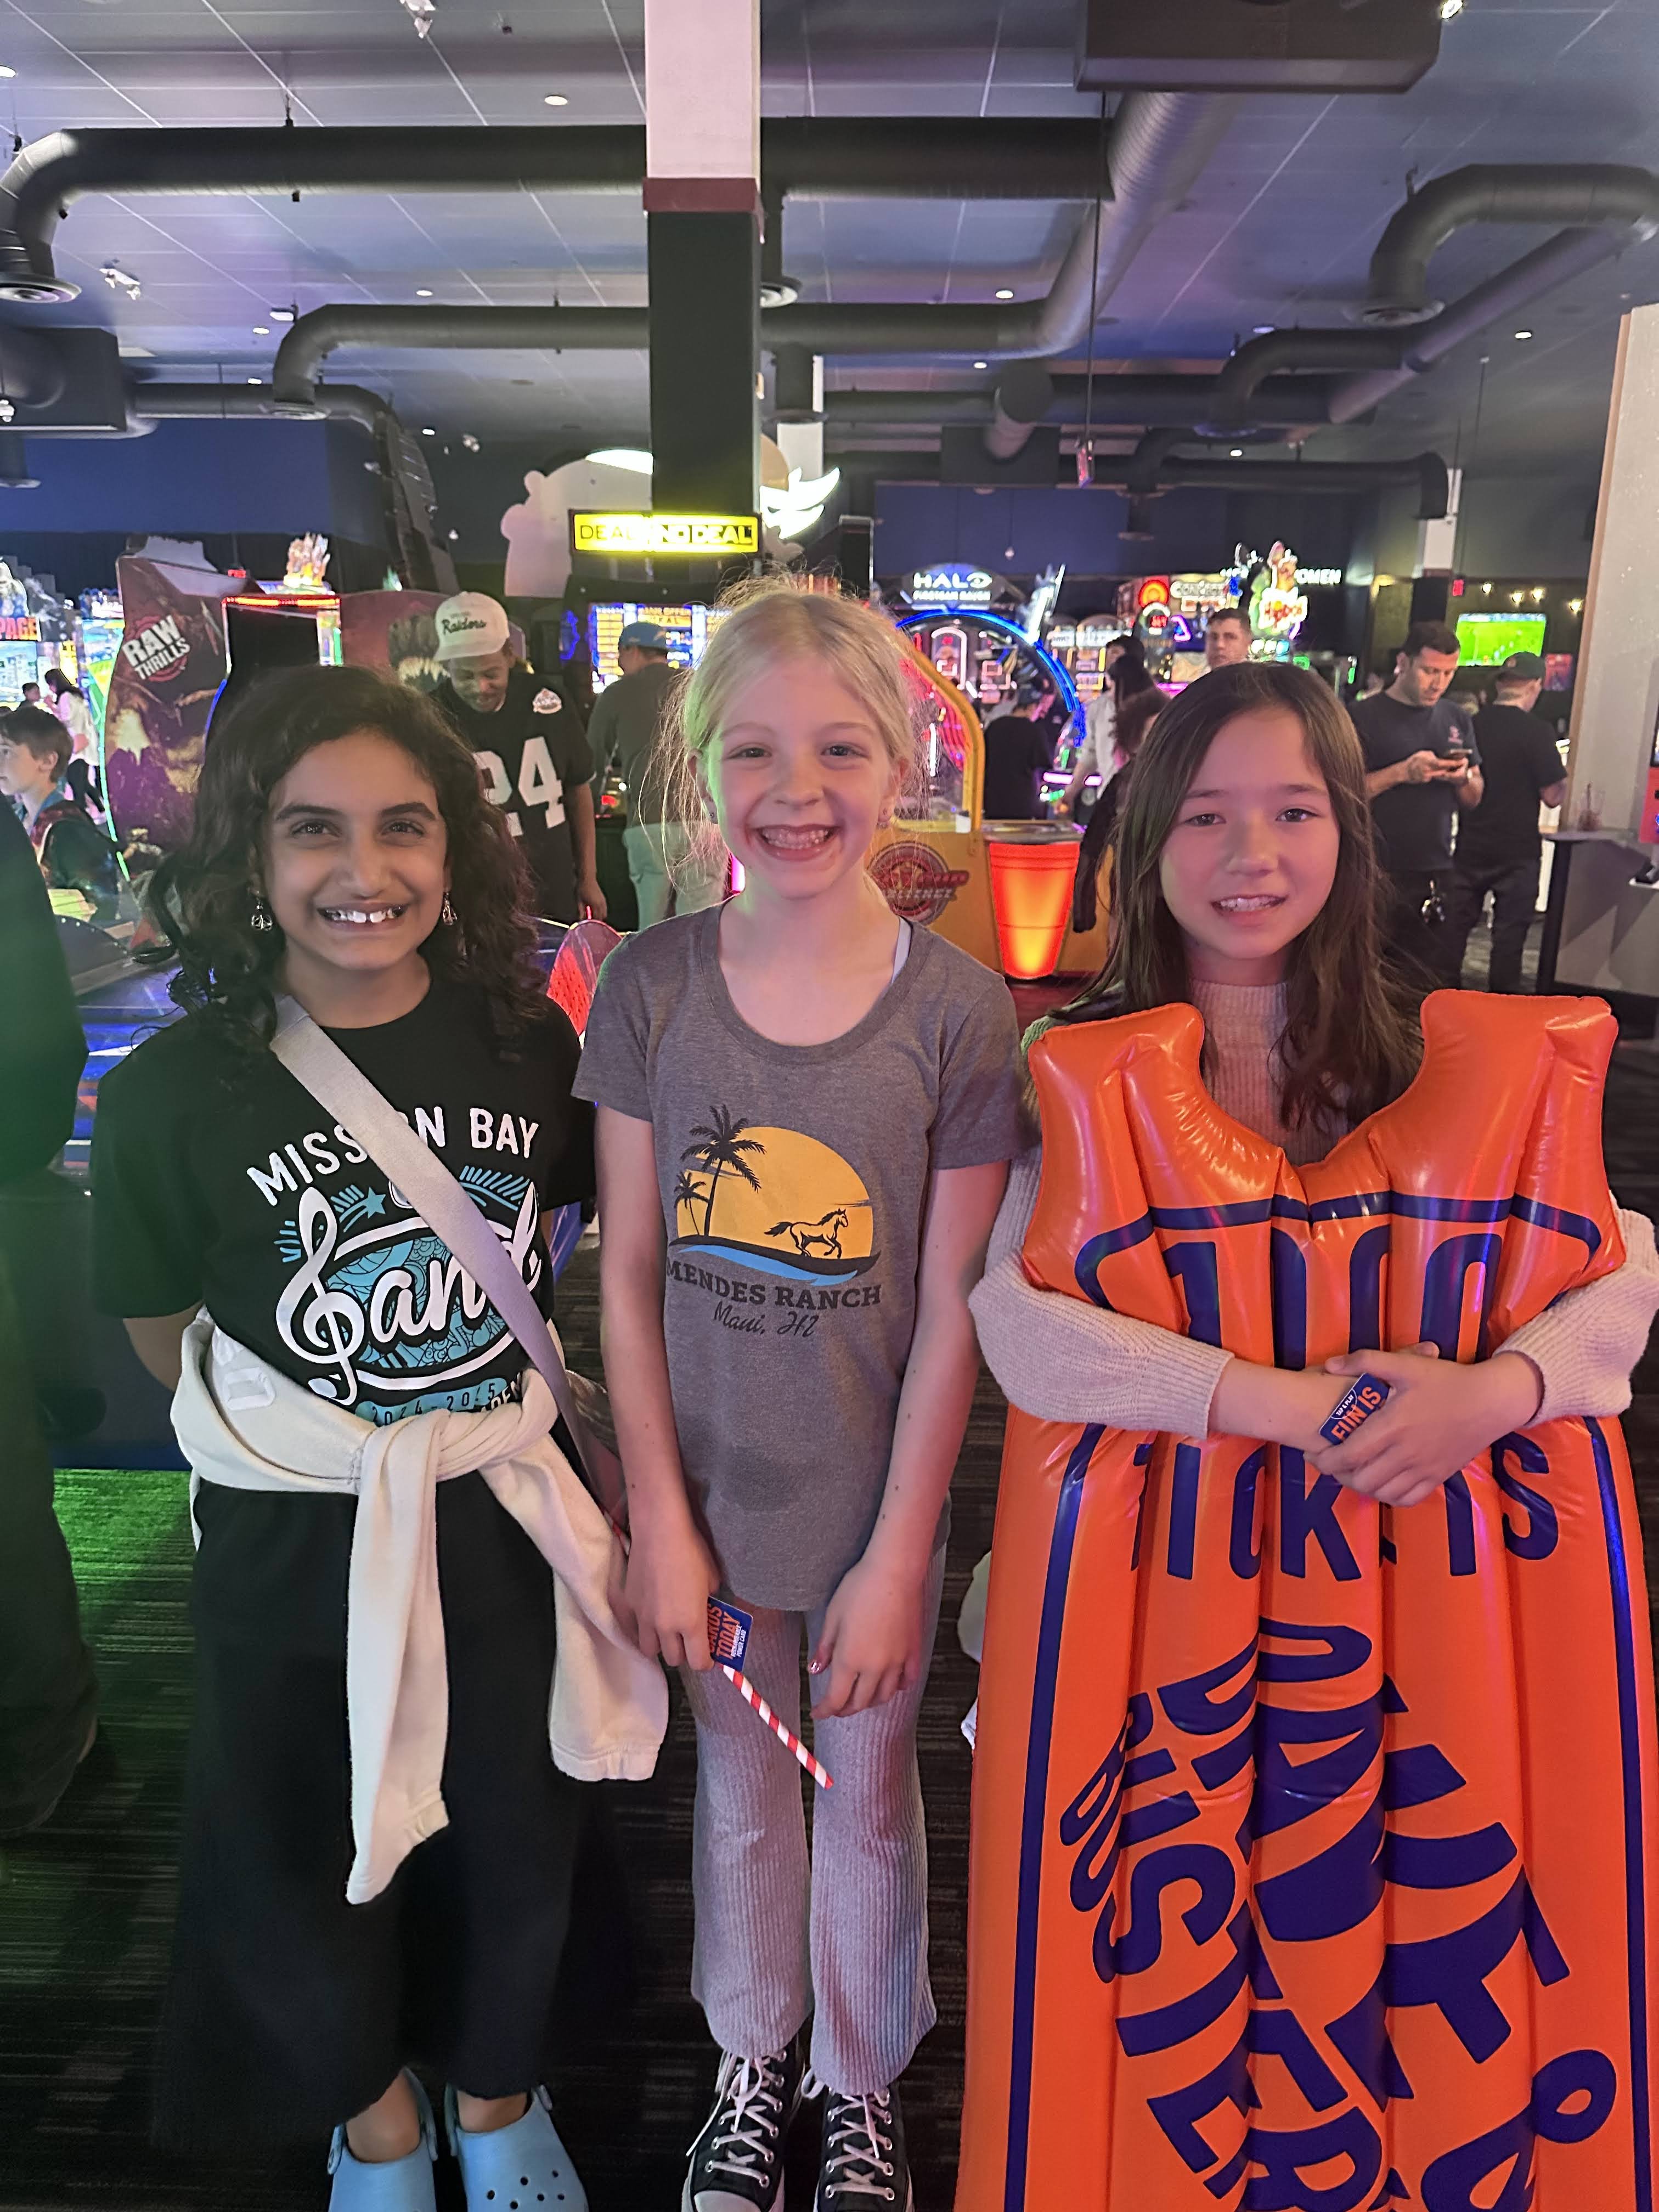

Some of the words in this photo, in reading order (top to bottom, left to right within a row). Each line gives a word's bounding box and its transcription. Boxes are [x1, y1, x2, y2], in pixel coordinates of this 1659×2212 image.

[580, 524, 636, 540] DEAL
[691, 524, 753, 544] DEAL
[913, 572, 992, 589] HALO
[122, 615, 180, 667] RAW
[441, 617, 487, 635] Raiders
[134, 637, 190, 680] THRILLS
[472, 736, 566, 837] 24
[247, 1106, 445, 1206] MISSN
[469, 1107, 539, 1159] BAY
[665, 1257, 766, 1304] MENDES
[774, 1284, 882, 1311] RANCH
[713, 1301, 766, 1335] Maui,
[1335, 1408, 1344, 1416] TAP
[1345, 1394, 1354, 1405] PLAY
[1357, 1386, 1381, 1410] IS
[1131, 1431, 1559, 1581] ICKS
[716, 1611, 740, 1660] TODAY
[1156, 1615, 1571, 2114] DAVE
[1059, 1692, 1413, 2212] BUSTER
